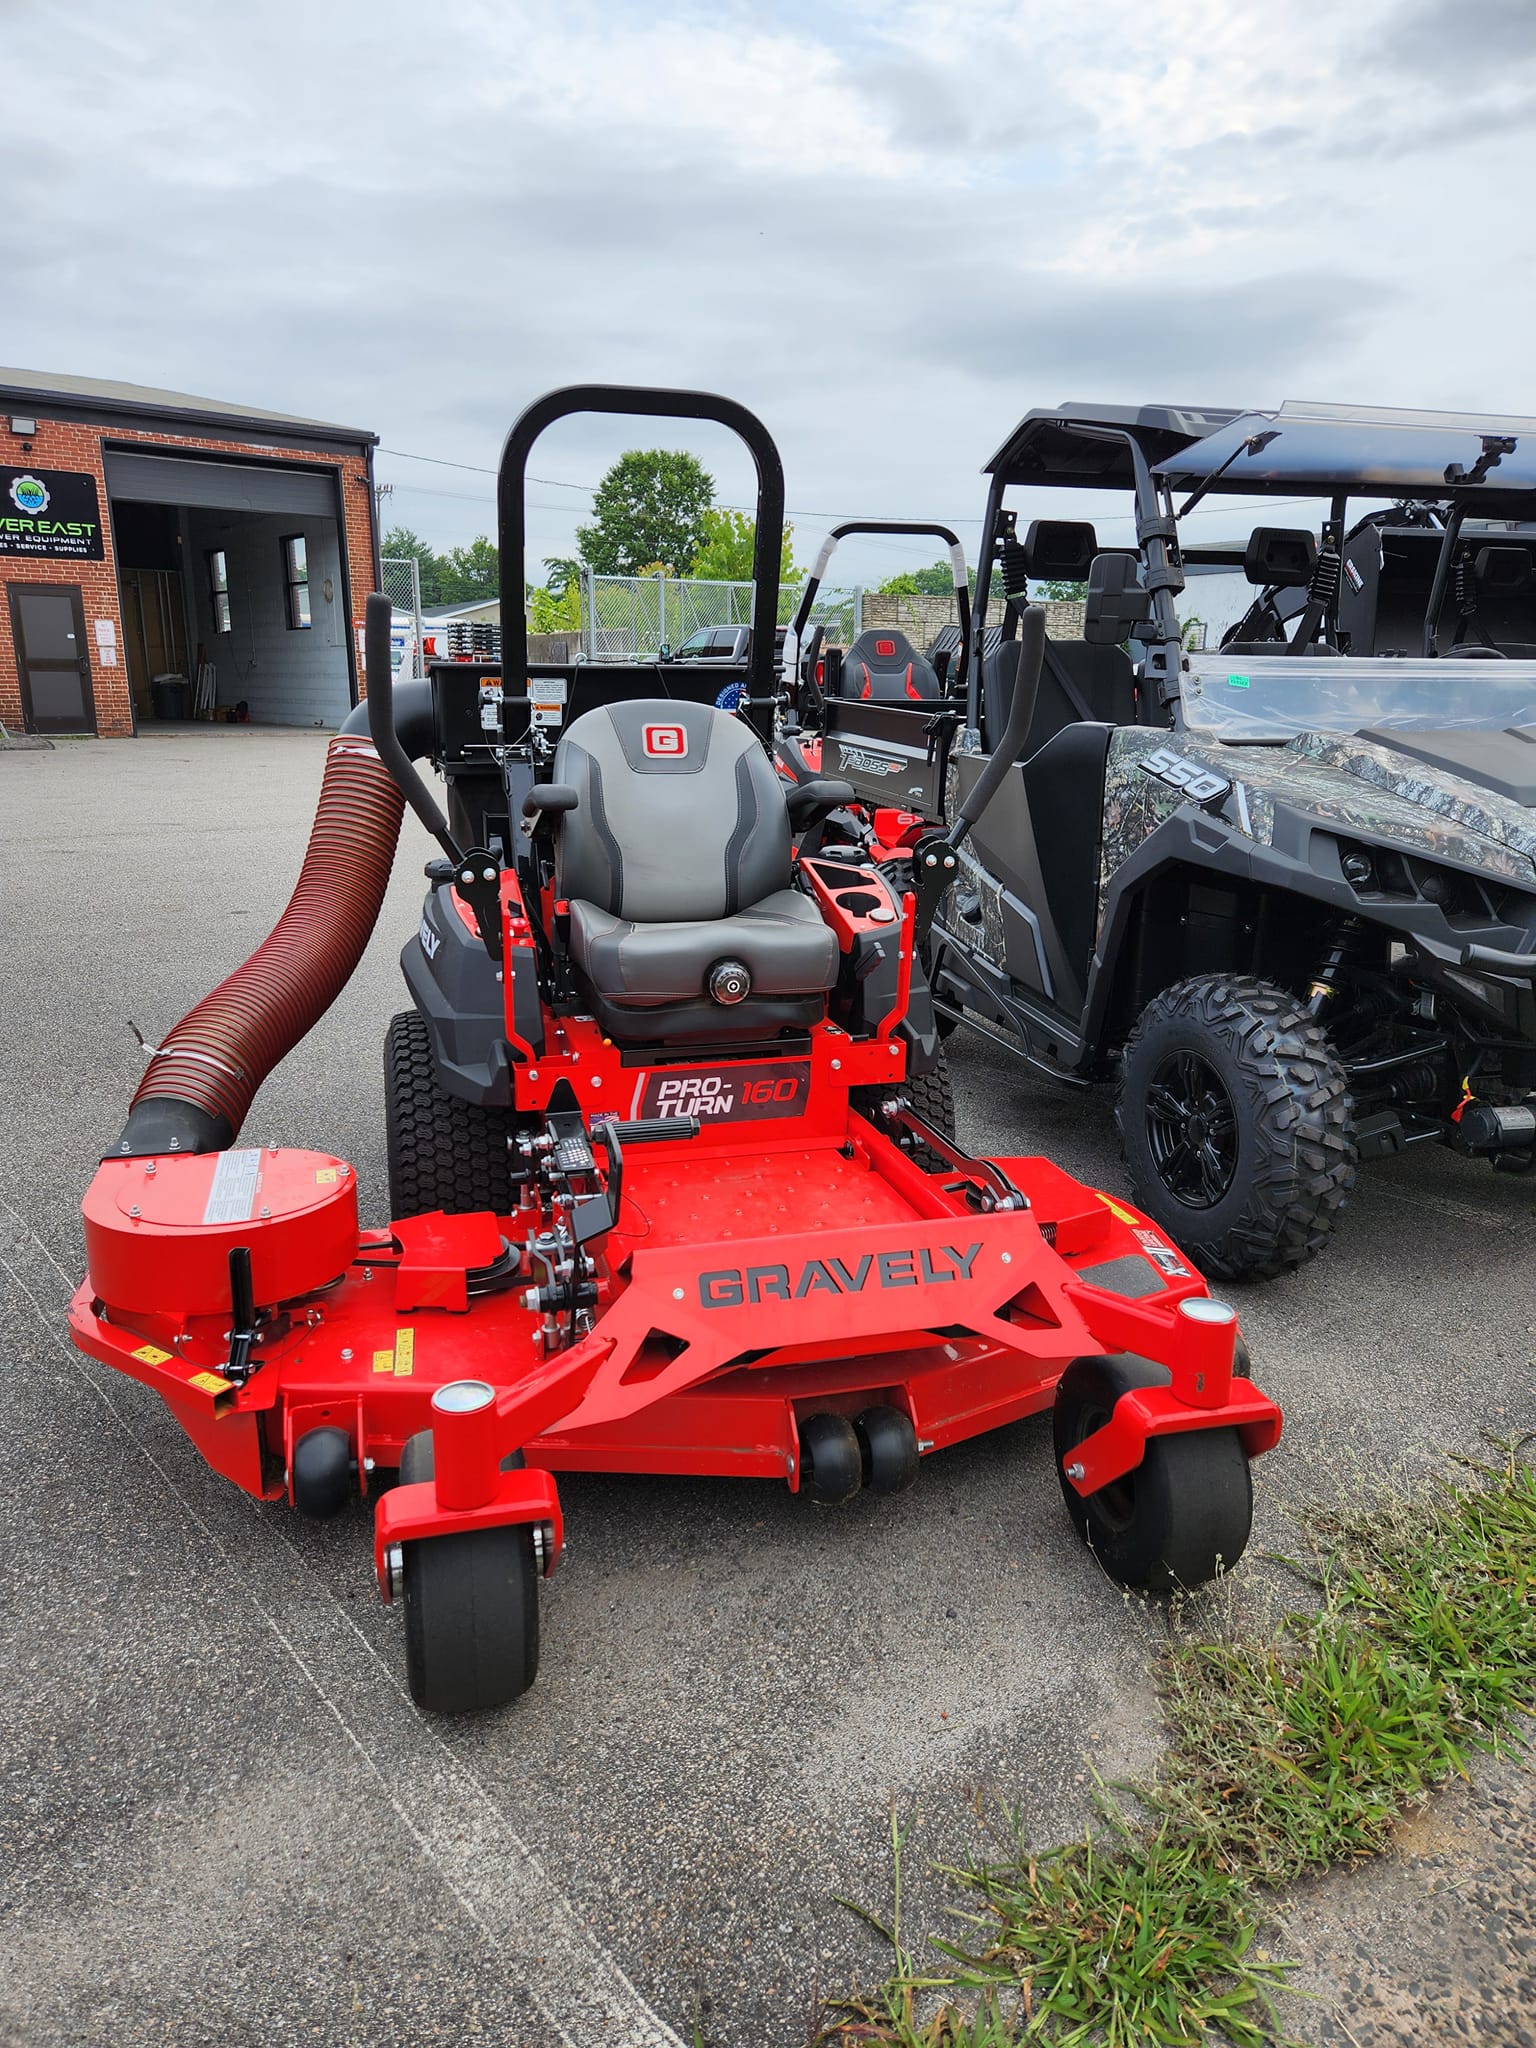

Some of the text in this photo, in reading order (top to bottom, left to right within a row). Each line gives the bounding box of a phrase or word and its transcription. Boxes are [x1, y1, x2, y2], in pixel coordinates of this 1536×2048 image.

[38, 520, 96, 537] EAST
[16, 543, 47, 551] SERVICE
[54, 545, 88, 553] SUPPLIES
[25, 535, 92, 546] EQUIPMENT
[1137, 747, 1230, 801] 550
[657, 1077, 732, 1099] PRO-
[741, 1078, 798, 1105] 160
[656, 1095, 734, 1118] TURN
[698, 1242, 984, 1309] GRAVELY
